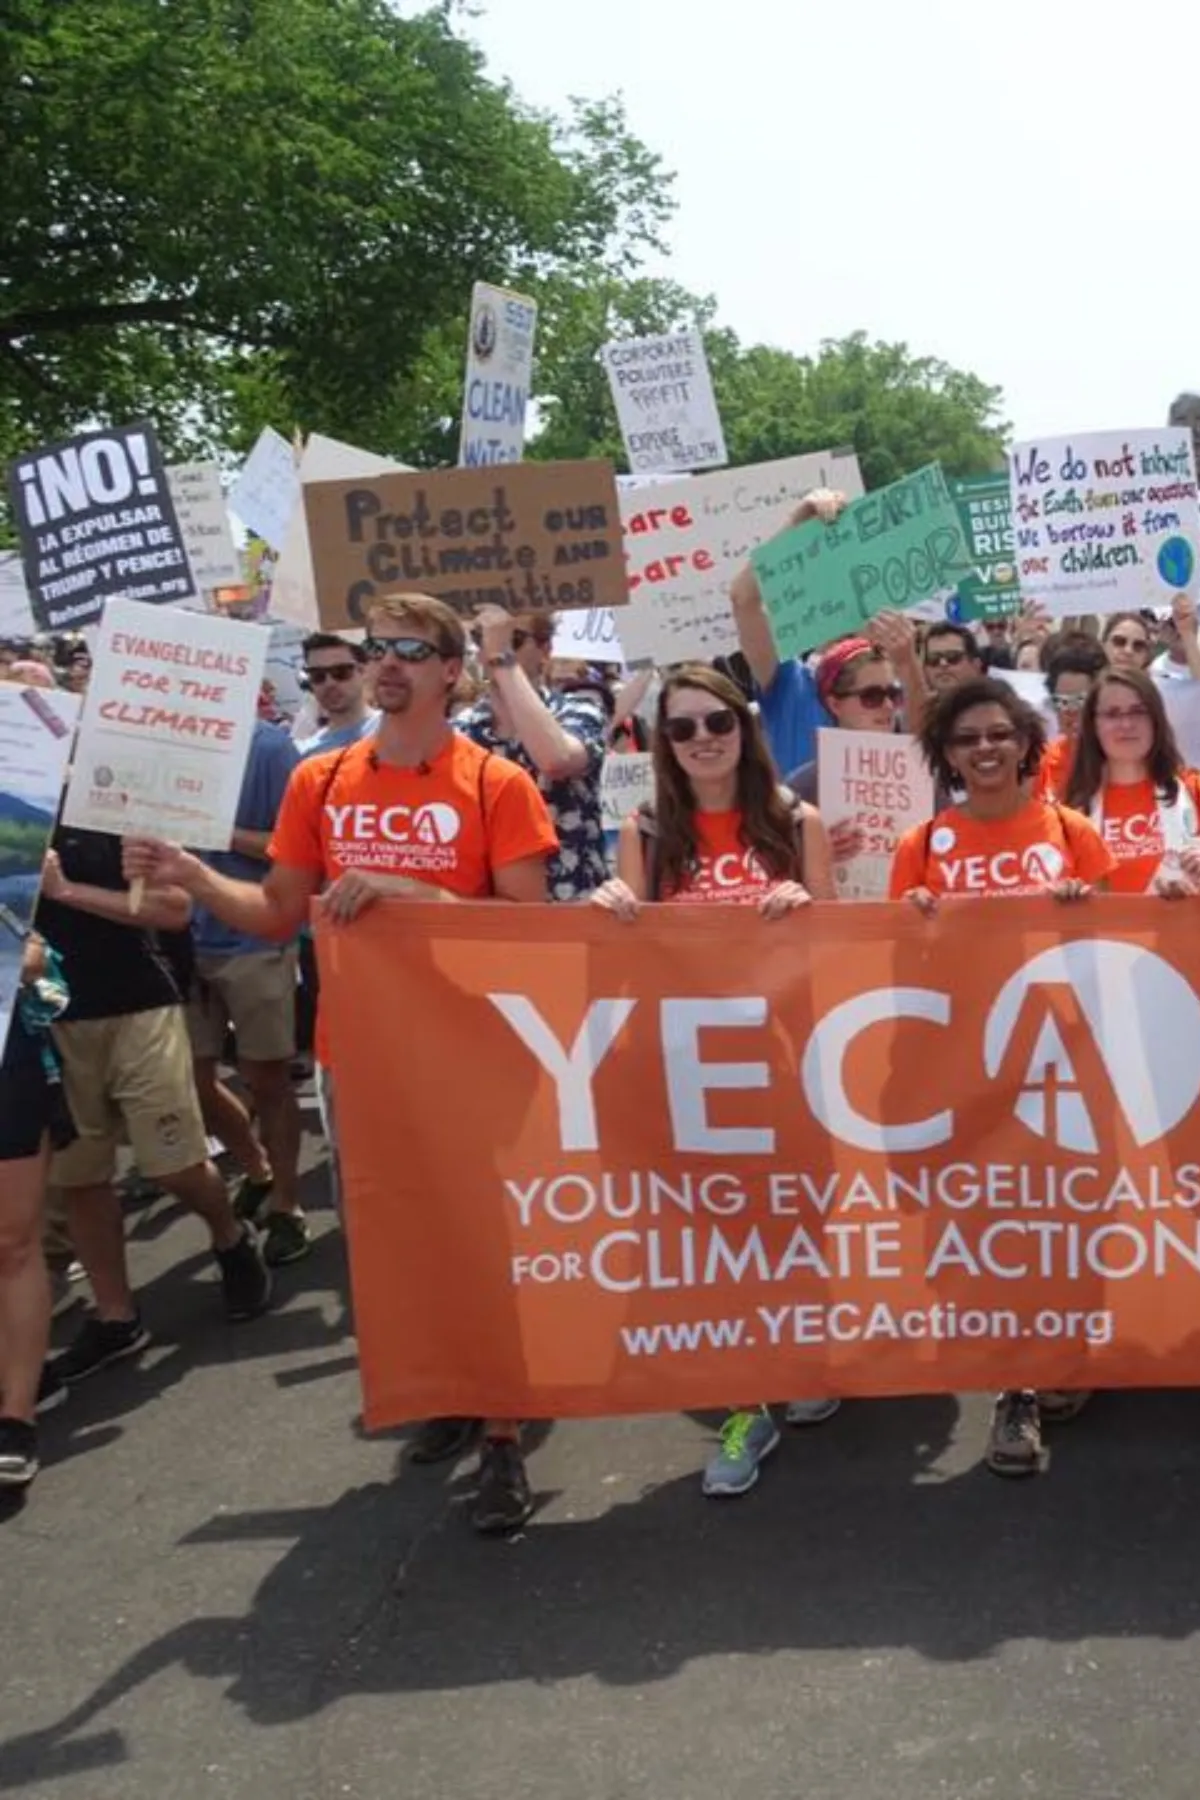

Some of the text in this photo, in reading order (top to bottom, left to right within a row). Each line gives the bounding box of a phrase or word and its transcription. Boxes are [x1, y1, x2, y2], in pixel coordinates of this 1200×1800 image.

[468, 378, 525, 427] CLEAN
[1014, 446, 1051, 487] We
[1060, 445, 1088, 482] do
[1093, 442, 1137, 479] not
[60, 504, 163, 545] EXPULSAR
[146, 525, 174, 546] DE
[345, 485, 515, 543] Protect
[621, 504, 694, 536] are
[1046, 522, 1116, 546] borrow
[367, 533, 611, 583] Climate AND
[973, 530, 1017, 556] RIS
[849, 526, 966, 620] POOR
[111, 632, 250, 678] EVANGELICALS
[119, 669, 229, 703] FOR THE
[98, 699, 237, 742] CLIMATE
[858, 748, 908, 780] HUG
[841, 778, 913, 812] TREES
[324, 801, 460, 844] YECA
[855, 811, 896, 830] FOR
[853, 831, 897, 854] ESU
[939, 841, 1063, 889] YECA
[506, 1171, 746, 1226] YOUNG
[511, 1254, 584, 1287] FOR
[590, 1222, 902, 1295] CLIMATE
[621, 1302, 1114, 1358] www.YECAction.org
